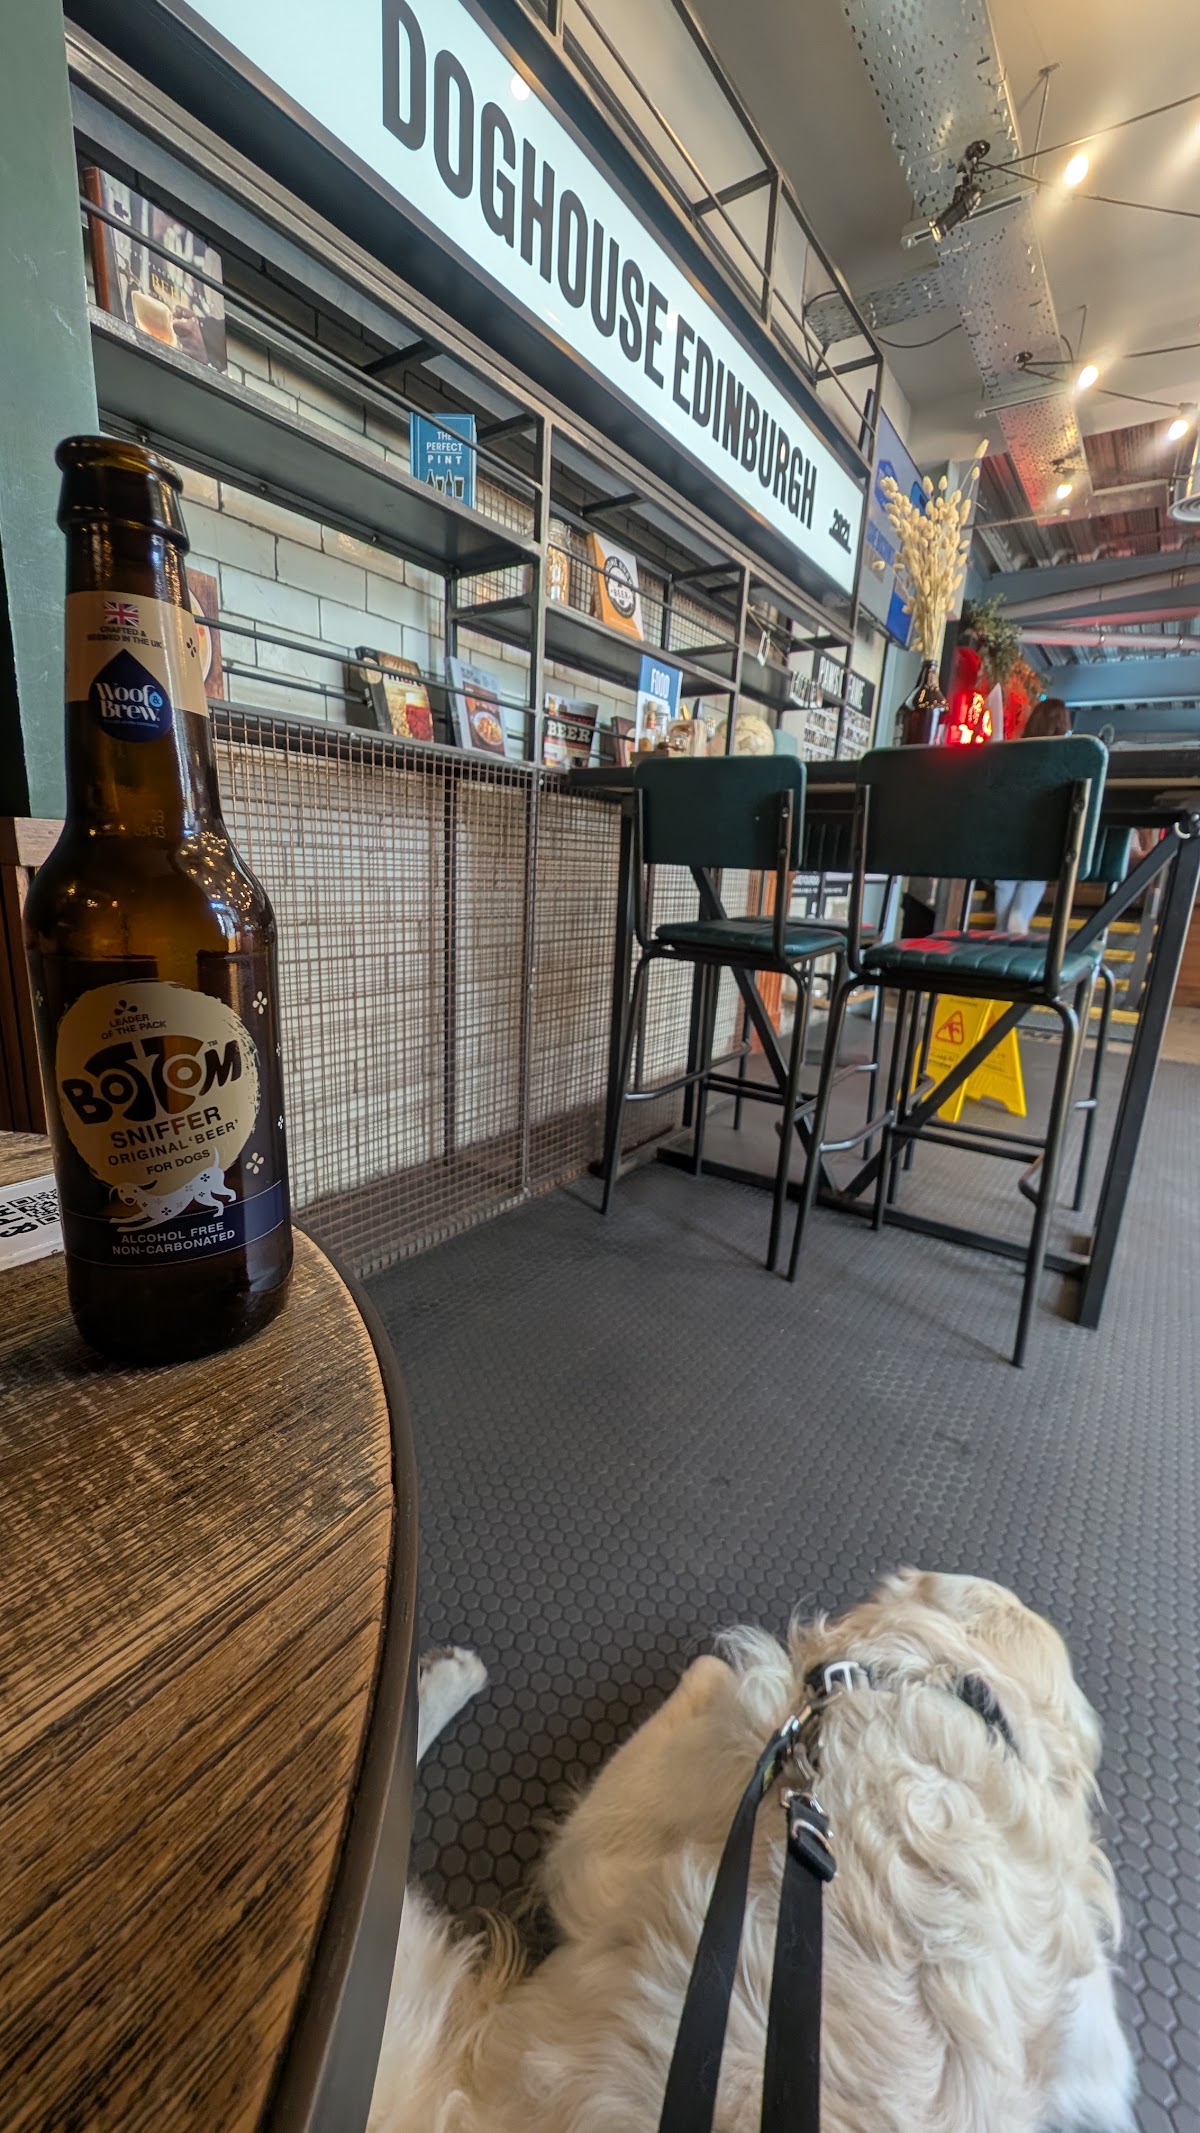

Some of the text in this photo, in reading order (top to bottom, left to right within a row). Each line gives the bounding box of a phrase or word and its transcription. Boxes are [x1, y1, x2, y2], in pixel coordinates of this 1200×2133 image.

[382, 0, 817, 530] DOGHOUSE EDINBURGH
[426, 442, 463, 452] PERFECT
[437, 431, 453, 441] THE
[427, 455, 462, 465] PINT
[101, 627, 147, 637] CRAFTED &
[122, 634, 131, 642] IN
[133, 636, 150, 646] THE
[151, 640, 163, 649] UK
[95, 682, 155, 707] Woof
[650, 668, 671, 699] FOOD
[547, 720, 592, 744] BEER
[102, 1020, 167, 1040] OF THE PACK
[109, 1014, 149, 1028] LEADER
[62, 1034, 242, 1125] BOTTOM
[110, 1106, 222, 1149] SNIFFER
[108, 1139, 189, 1166] ORIGINAL
[146, 1149, 211, 1176] FOR DOGS
[112, 1229, 236, 1255] NON-CARBONATED
[121, 1221, 225, 1244] ALCOHOL FREE
